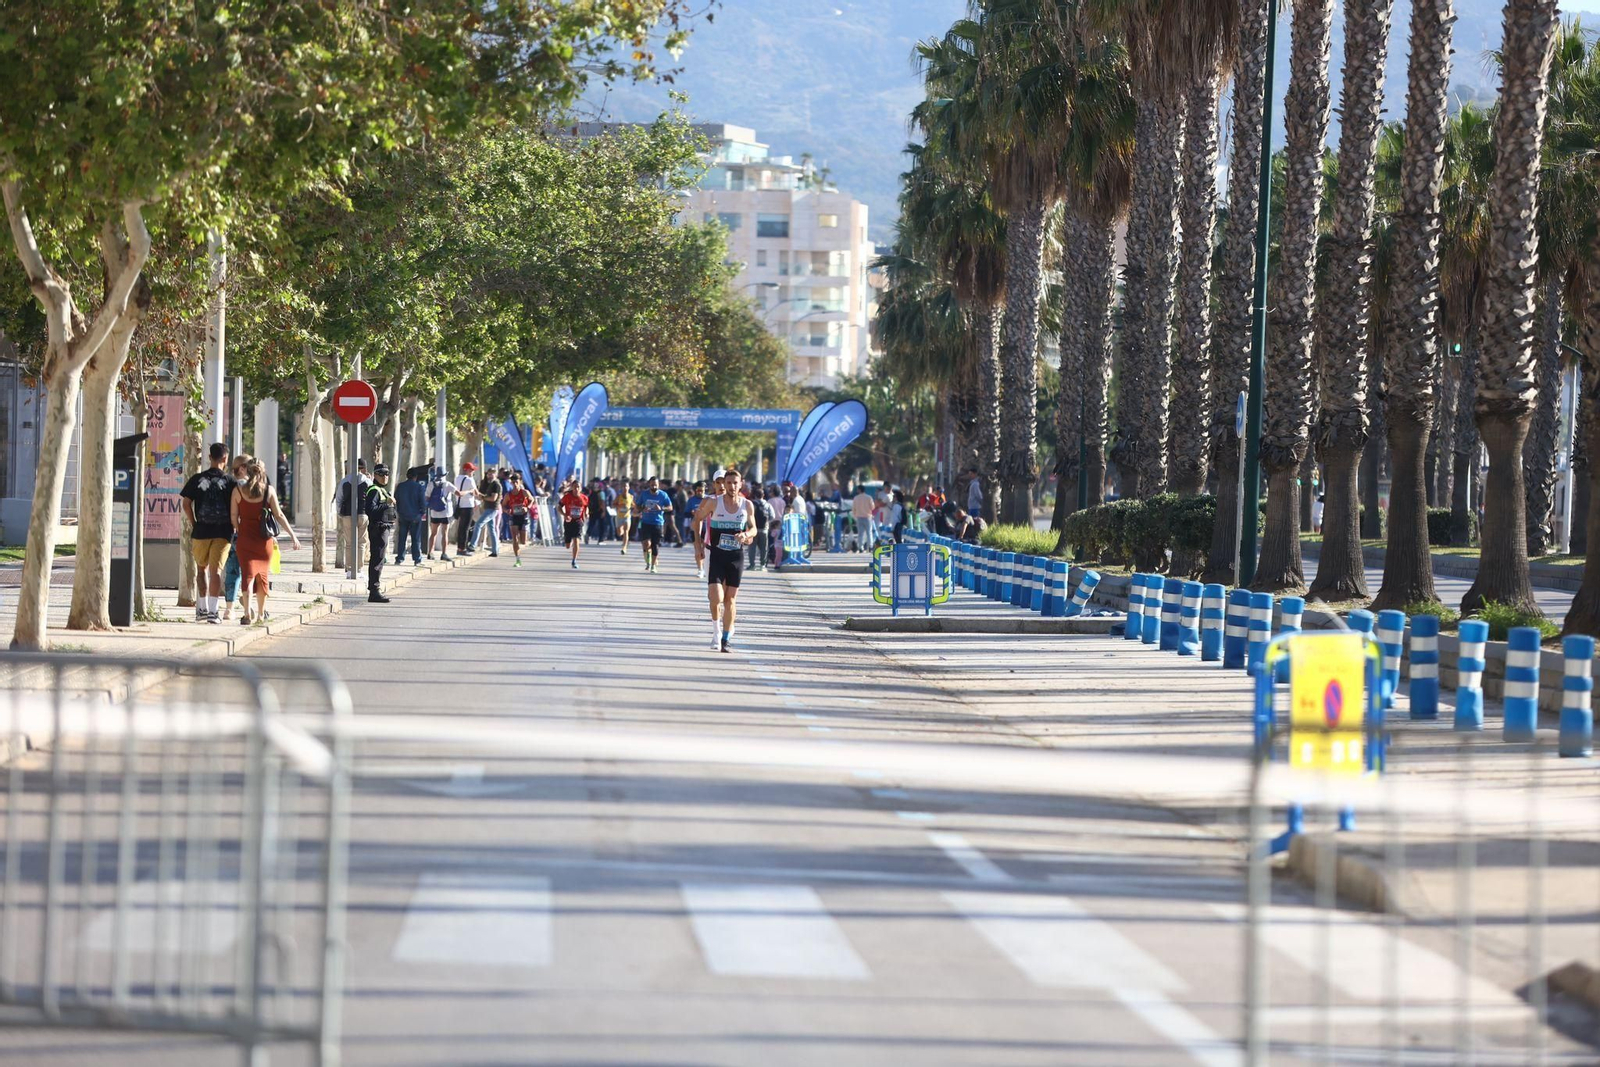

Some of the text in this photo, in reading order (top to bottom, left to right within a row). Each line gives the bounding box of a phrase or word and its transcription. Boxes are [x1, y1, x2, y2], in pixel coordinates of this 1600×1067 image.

[565, 398, 599, 456] mayoral
[742, 413, 792, 426] mayoral
[803, 415, 854, 467] mayoral
[114, 470, 128, 487] P
